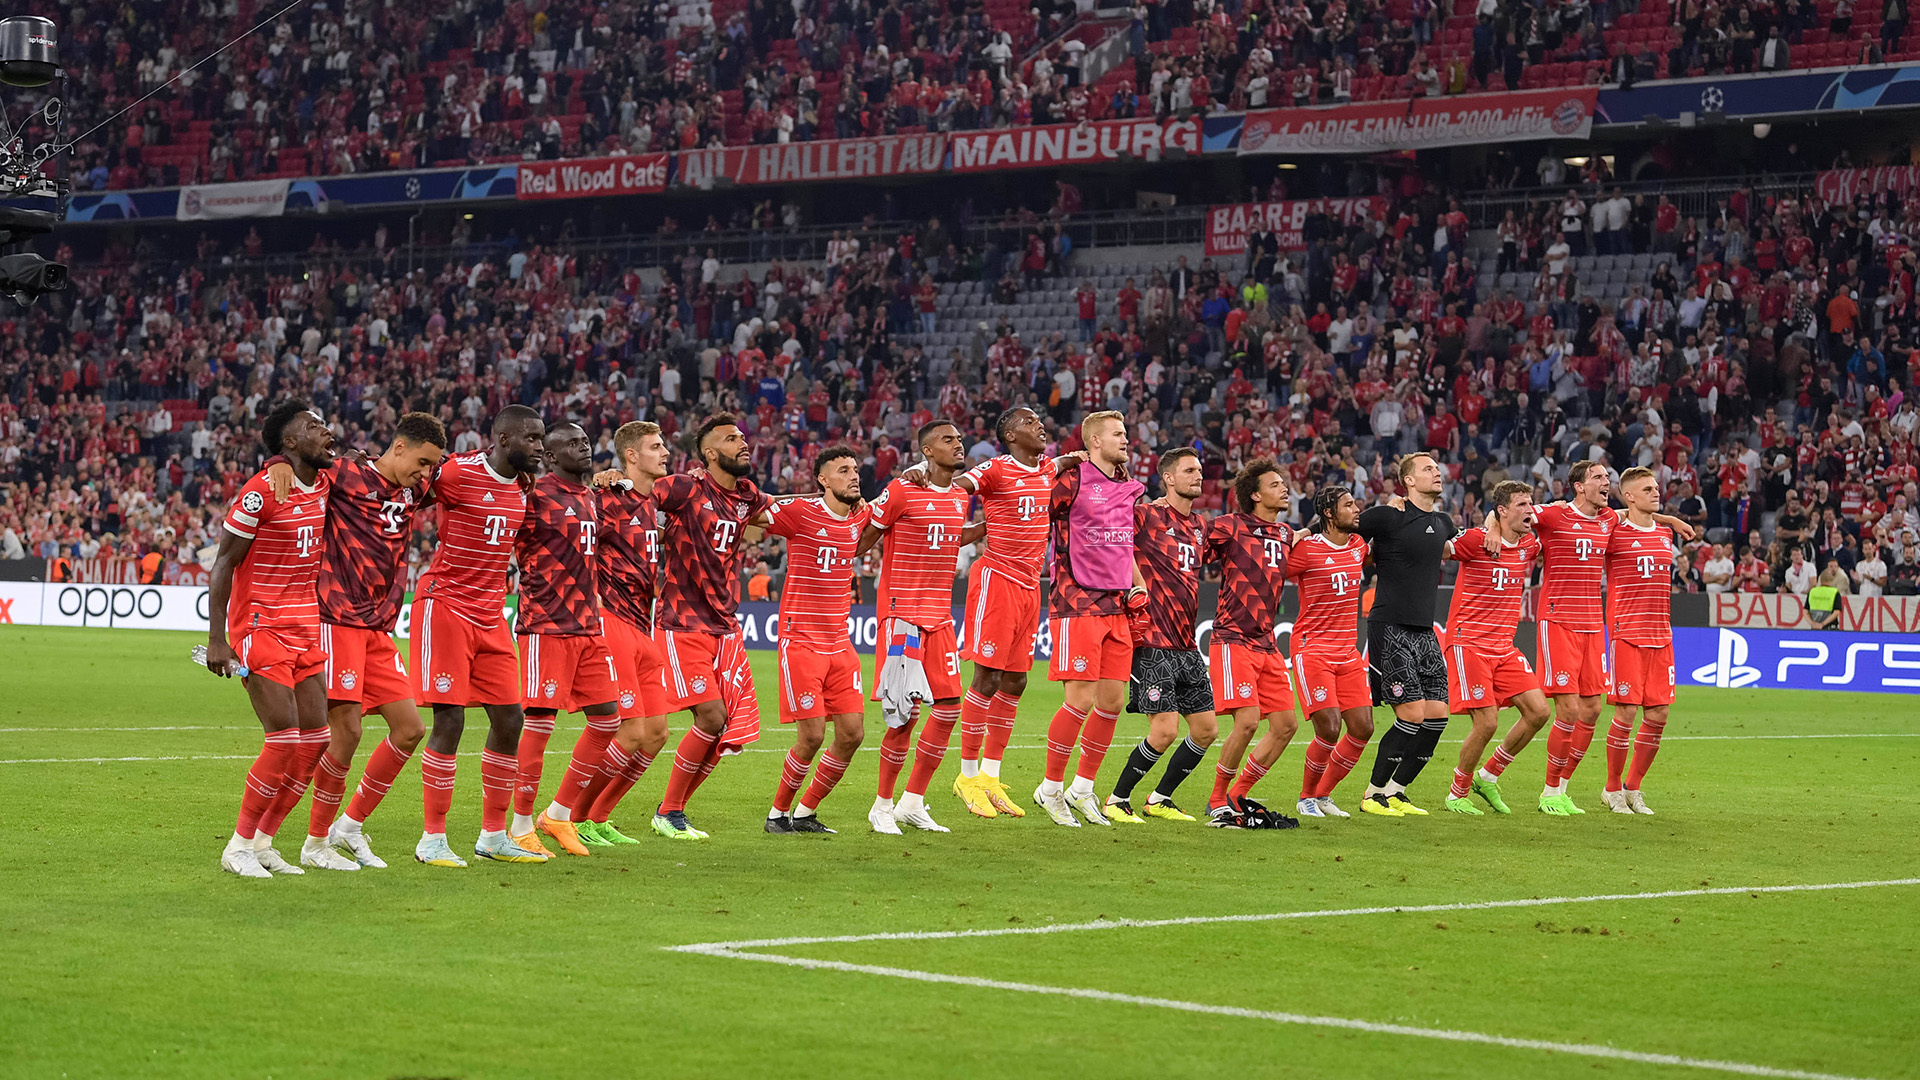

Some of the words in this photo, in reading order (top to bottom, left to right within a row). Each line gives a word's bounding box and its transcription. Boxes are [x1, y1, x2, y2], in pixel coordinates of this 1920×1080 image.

[955, 120, 1197, 168] MAINBURG
[1297, 119, 1358, 146] OLDIE
[1452, 108, 1502, 138] 2000
[520, 167, 557, 194] Red
[562, 162, 615, 191] Wood
[620, 160, 667, 188] Cats
[757, 134, 944, 181] HALLERTAU
[59, 586, 162, 627] oppo
[1716, 594, 1803, 627] BAD
[1668, 665, 1675, 686] 6
[1777, 640, 1920, 687] PS5
